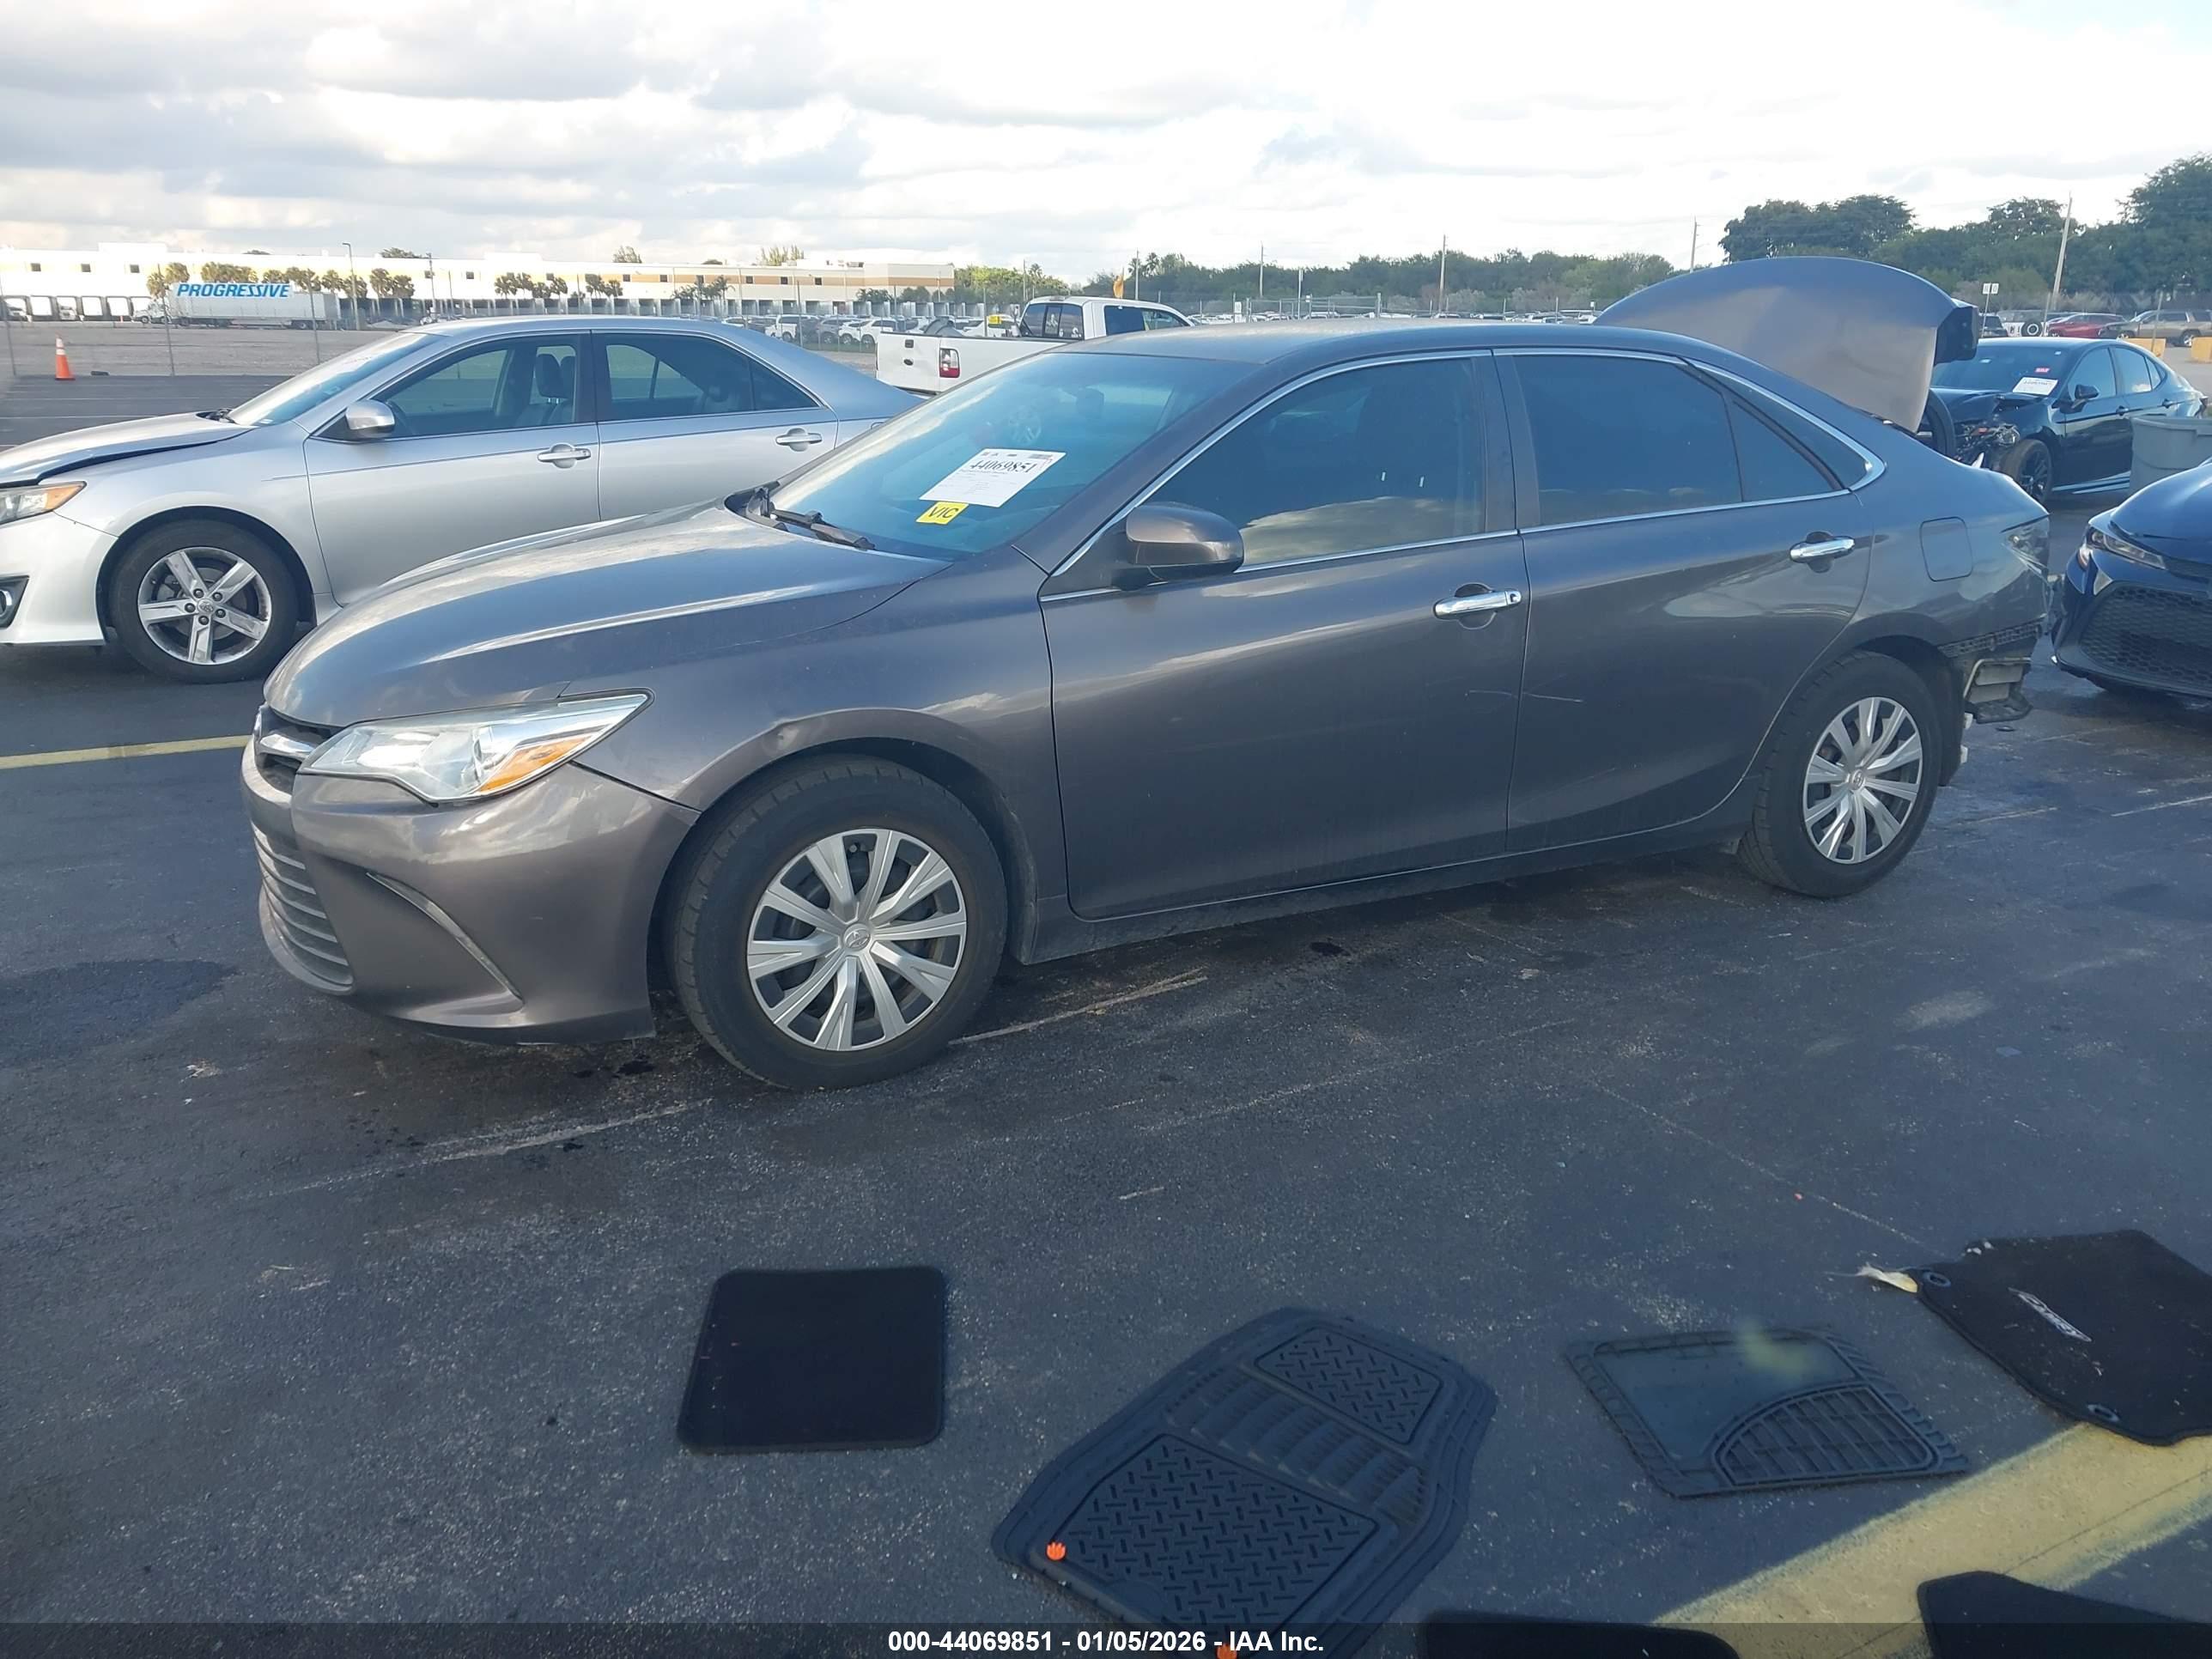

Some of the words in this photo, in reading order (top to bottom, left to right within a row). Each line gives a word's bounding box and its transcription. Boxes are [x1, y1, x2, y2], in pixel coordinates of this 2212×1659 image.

[177, 283, 289, 297] PROGRESSIVE
[971, 460, 1037, 472] 44069851
[927, 506, 960, 519] VIC
